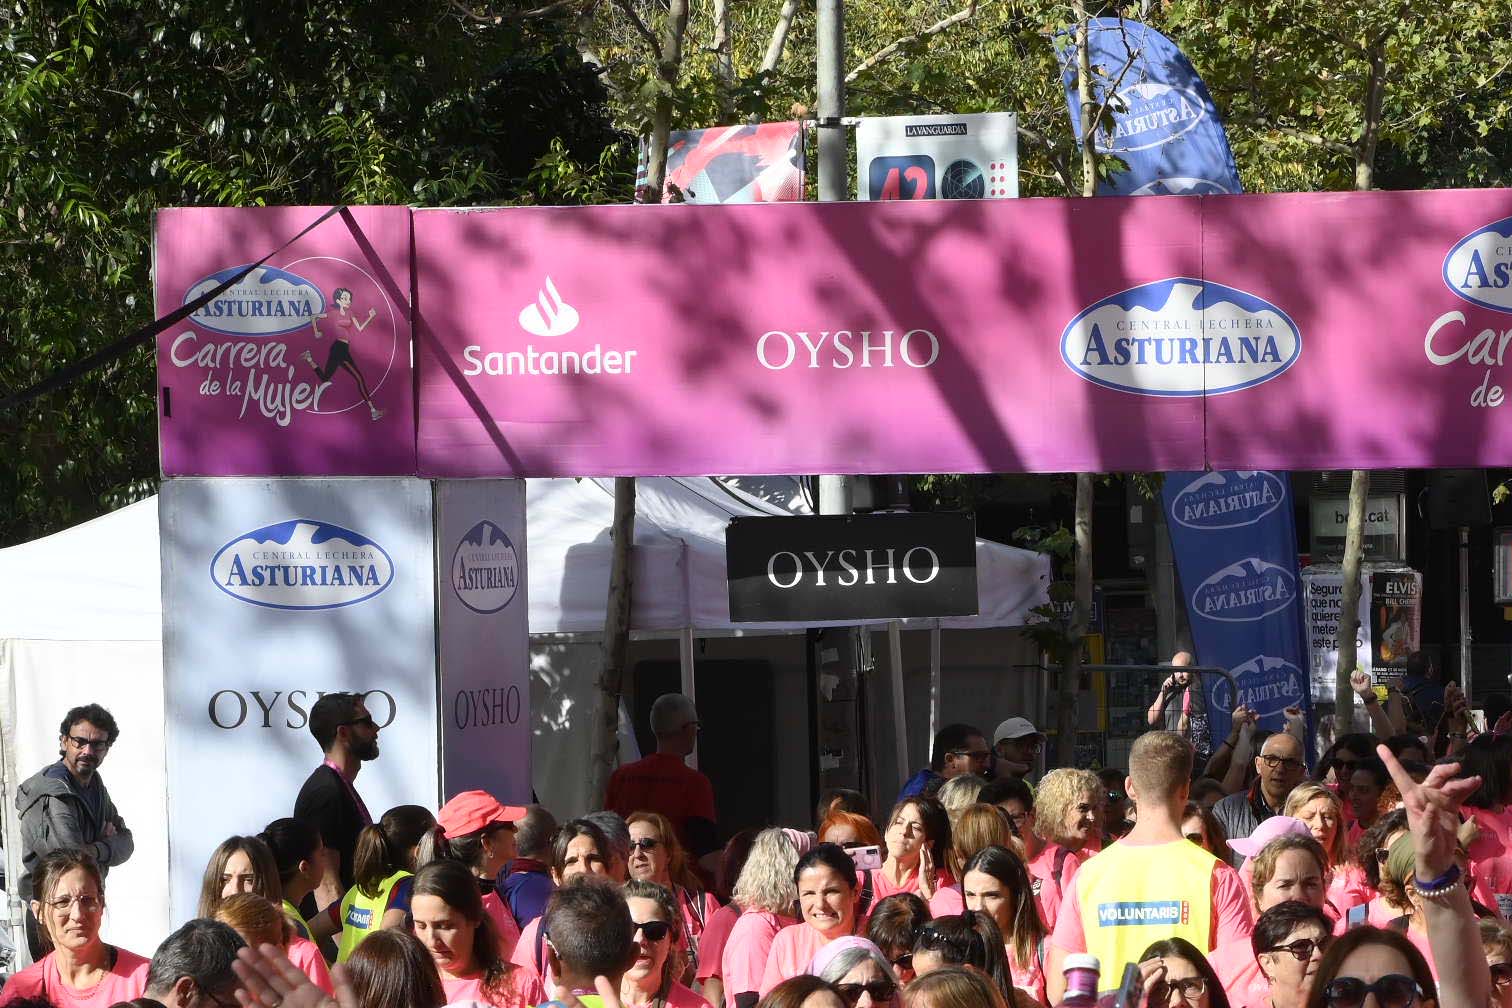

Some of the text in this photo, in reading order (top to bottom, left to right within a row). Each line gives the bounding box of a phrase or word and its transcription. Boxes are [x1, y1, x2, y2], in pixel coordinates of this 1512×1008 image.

[1116, 317, 1275, 332] CENTRAL LECHERA
[170, 330, 288, 369] Carrera
[463, 344, 638, 376] Santander
[756, 328, 940, 371] OYSHO
[1080, 325, 1283, 366] ASTURIANA
[200, 365, 332, 427] de la Mujer
[1470, 369, 1504, 408] de
[225, 553, 381, 587] ASTURIANA
[252, 550, 376, 561] CENTRAL LECHERA
[457, 554, 515, 591] ASTURIANA
[767, 546, 940, 588] OYSHO
[1386, 582, 1416, 594] ELVIS
[1312, 638, 1331, 648] este
[208, 688, 397, 729] OYSO
[454, 685, 521, 730] OYSHO
